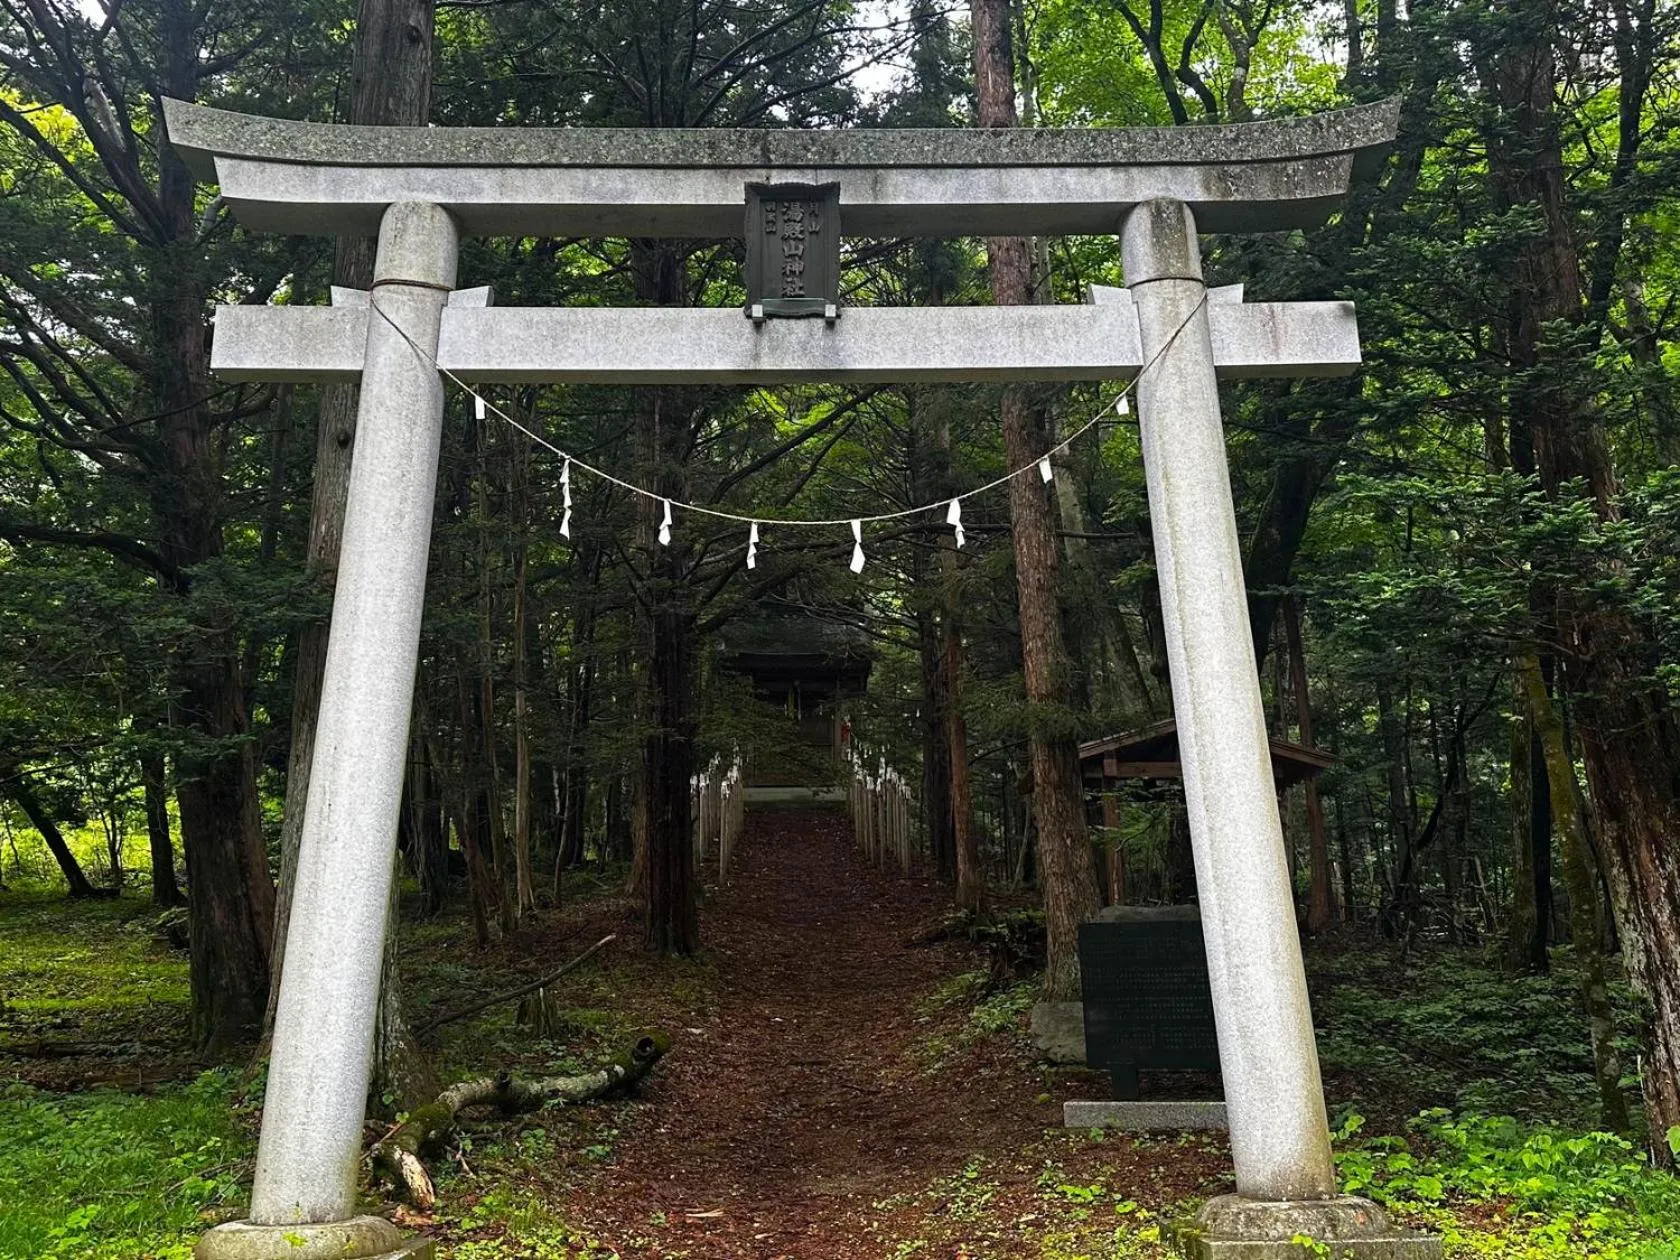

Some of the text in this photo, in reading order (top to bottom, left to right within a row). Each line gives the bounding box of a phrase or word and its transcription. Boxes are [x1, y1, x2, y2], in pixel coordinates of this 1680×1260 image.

[781, 201, 805, 297] 湯殿山神社
